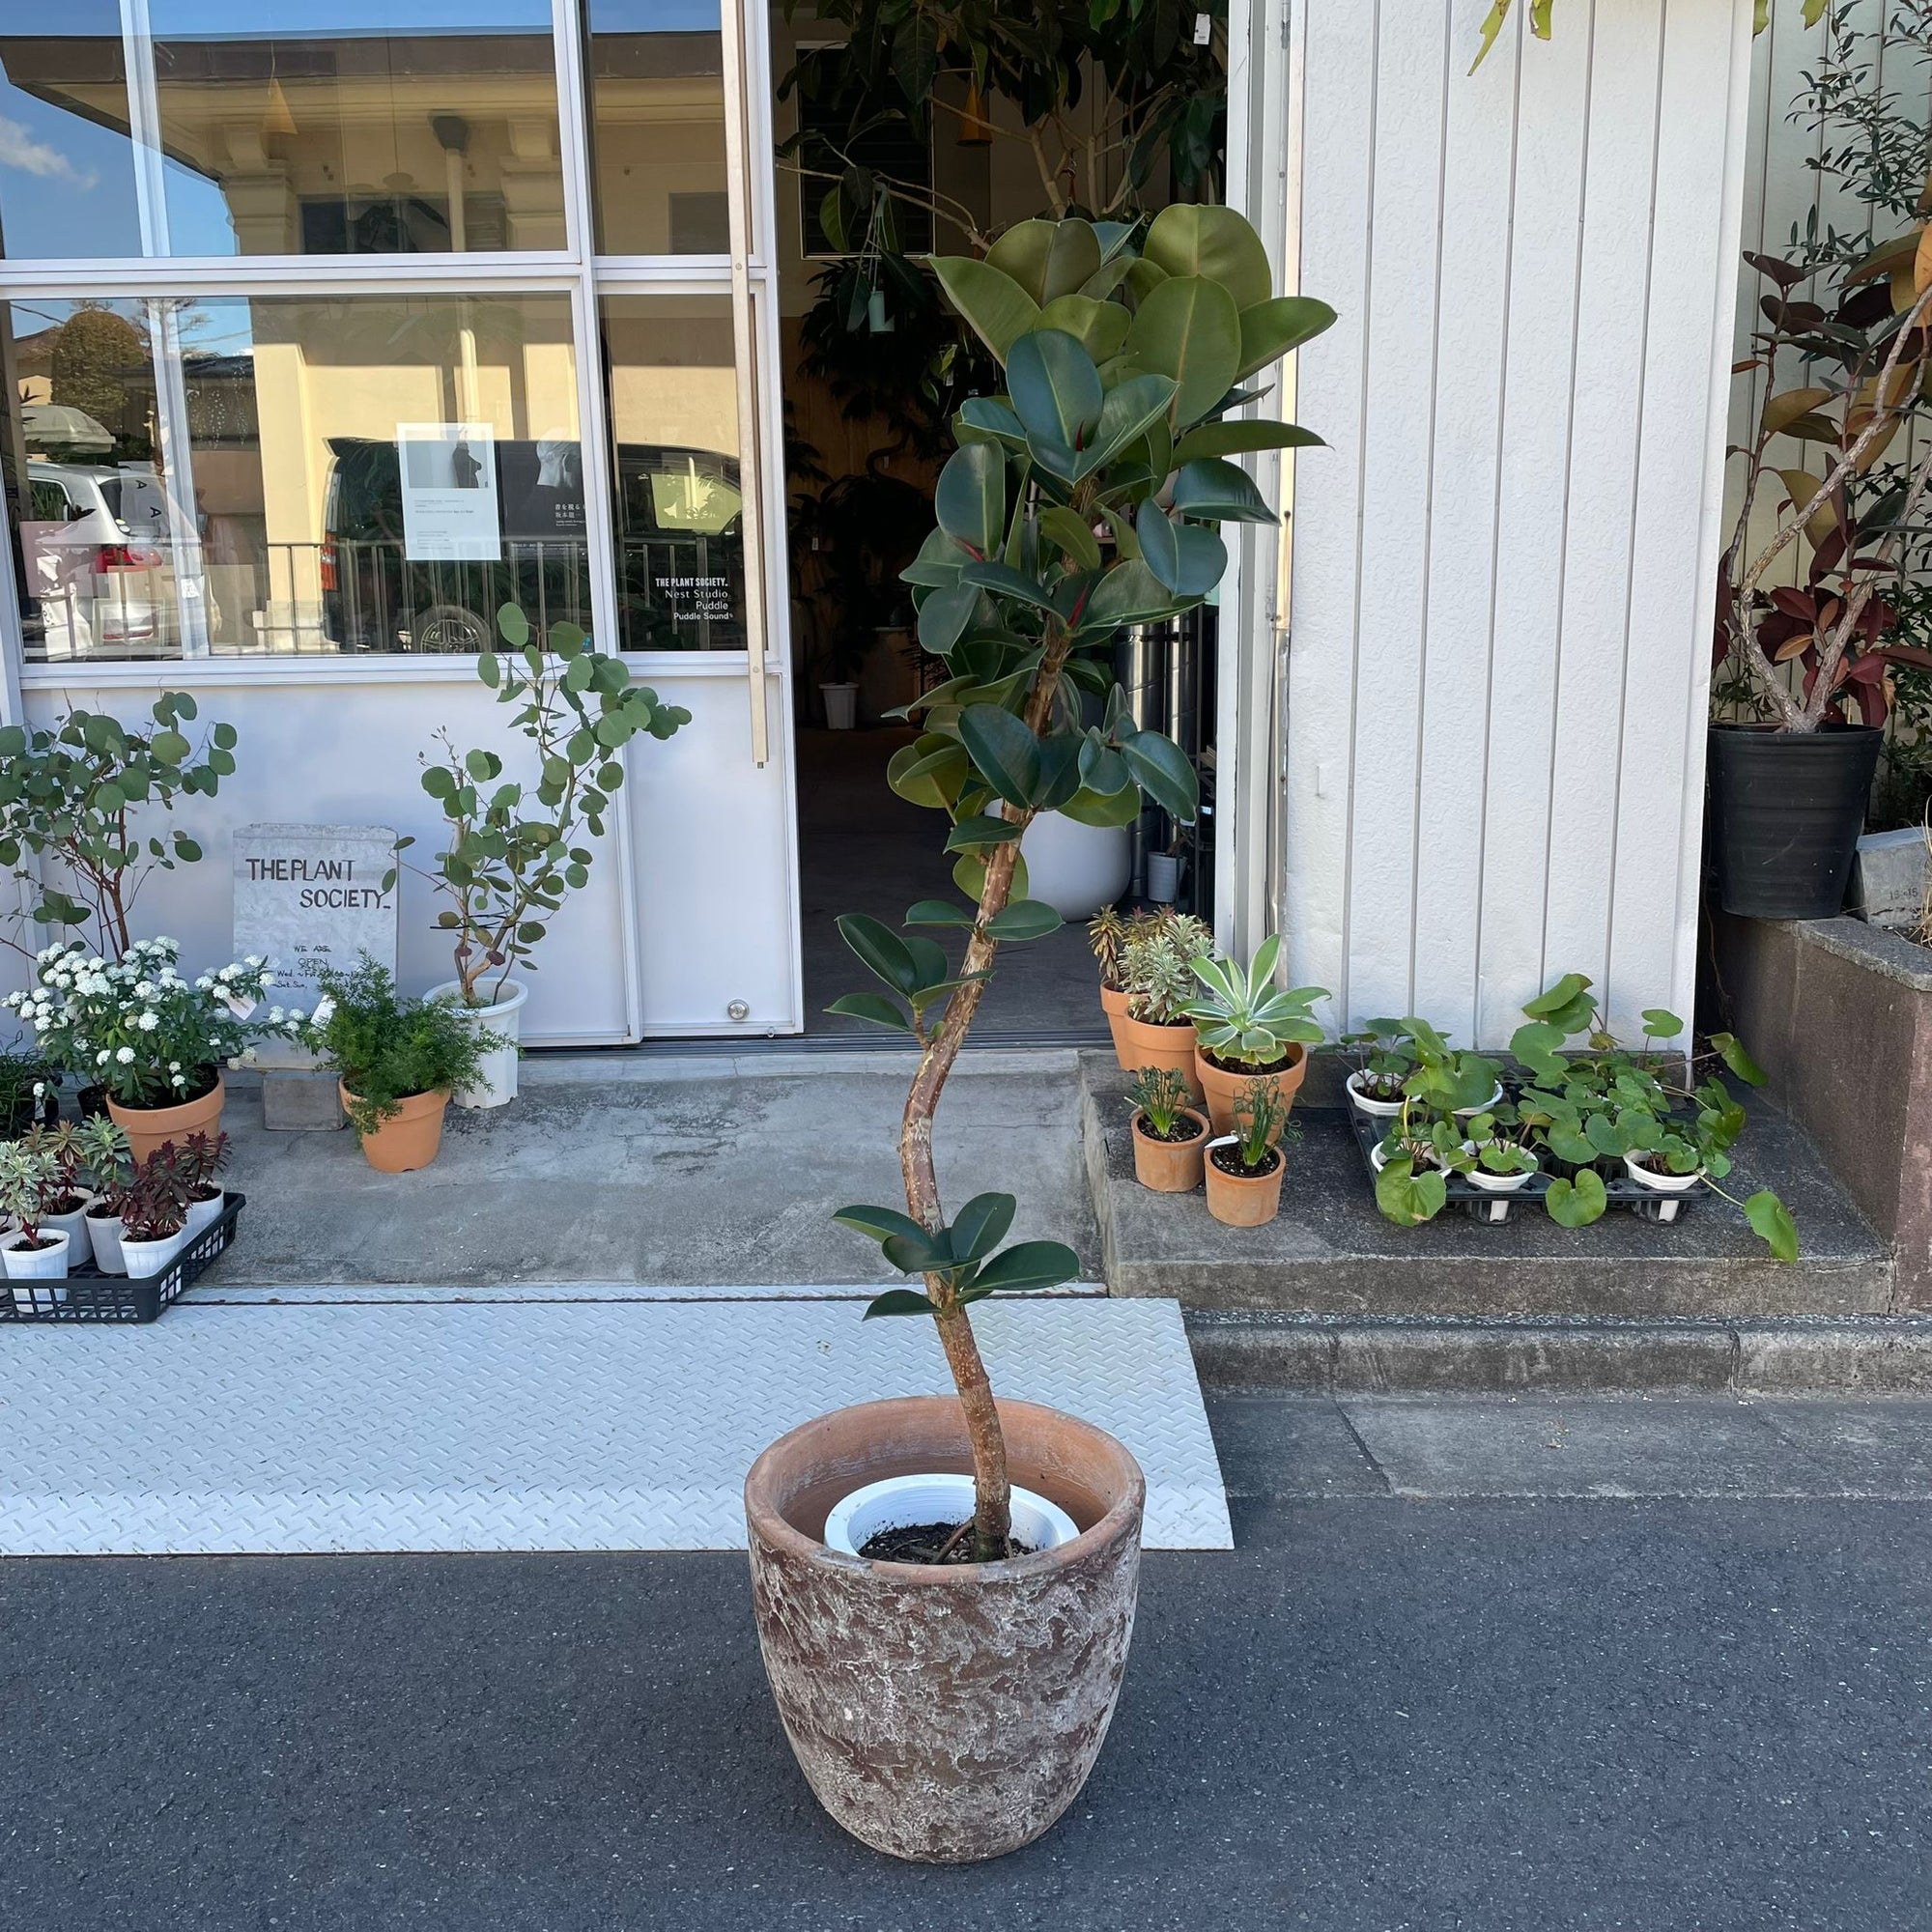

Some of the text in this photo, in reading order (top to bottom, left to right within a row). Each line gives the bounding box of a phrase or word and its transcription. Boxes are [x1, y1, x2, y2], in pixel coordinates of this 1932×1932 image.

[655, 578, 728, 587] THE PLANT SOCIETY.
[665, 589, 728, 599] Nest Studio
[696, 601, 728, 610] Puddle
